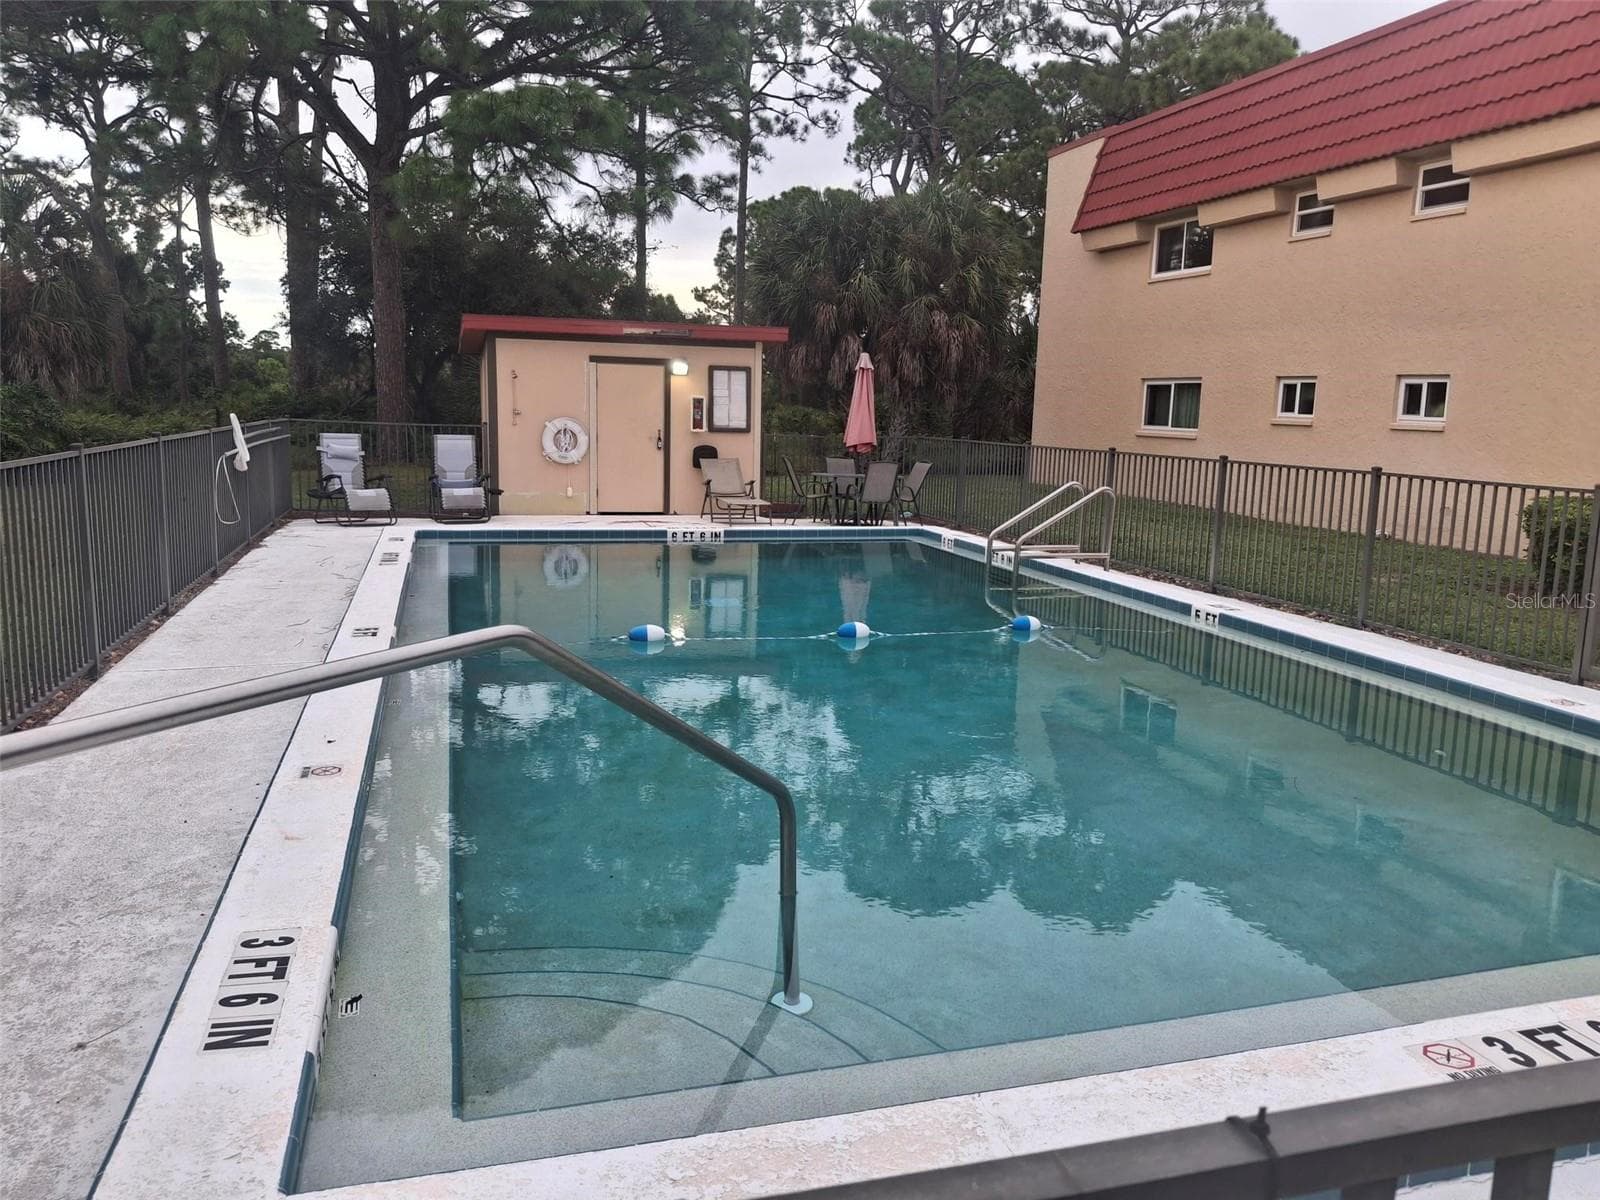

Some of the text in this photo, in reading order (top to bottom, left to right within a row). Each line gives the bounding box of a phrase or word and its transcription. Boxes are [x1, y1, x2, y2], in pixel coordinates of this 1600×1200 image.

[1205, 613, 1217, 624] FT
[202, 935, 295, 1051] 3 FT 6 IN
[1481, 1024, 1600, 1068] 3 FT
[1447, 1065, 1503, 1081] NO DIVING
